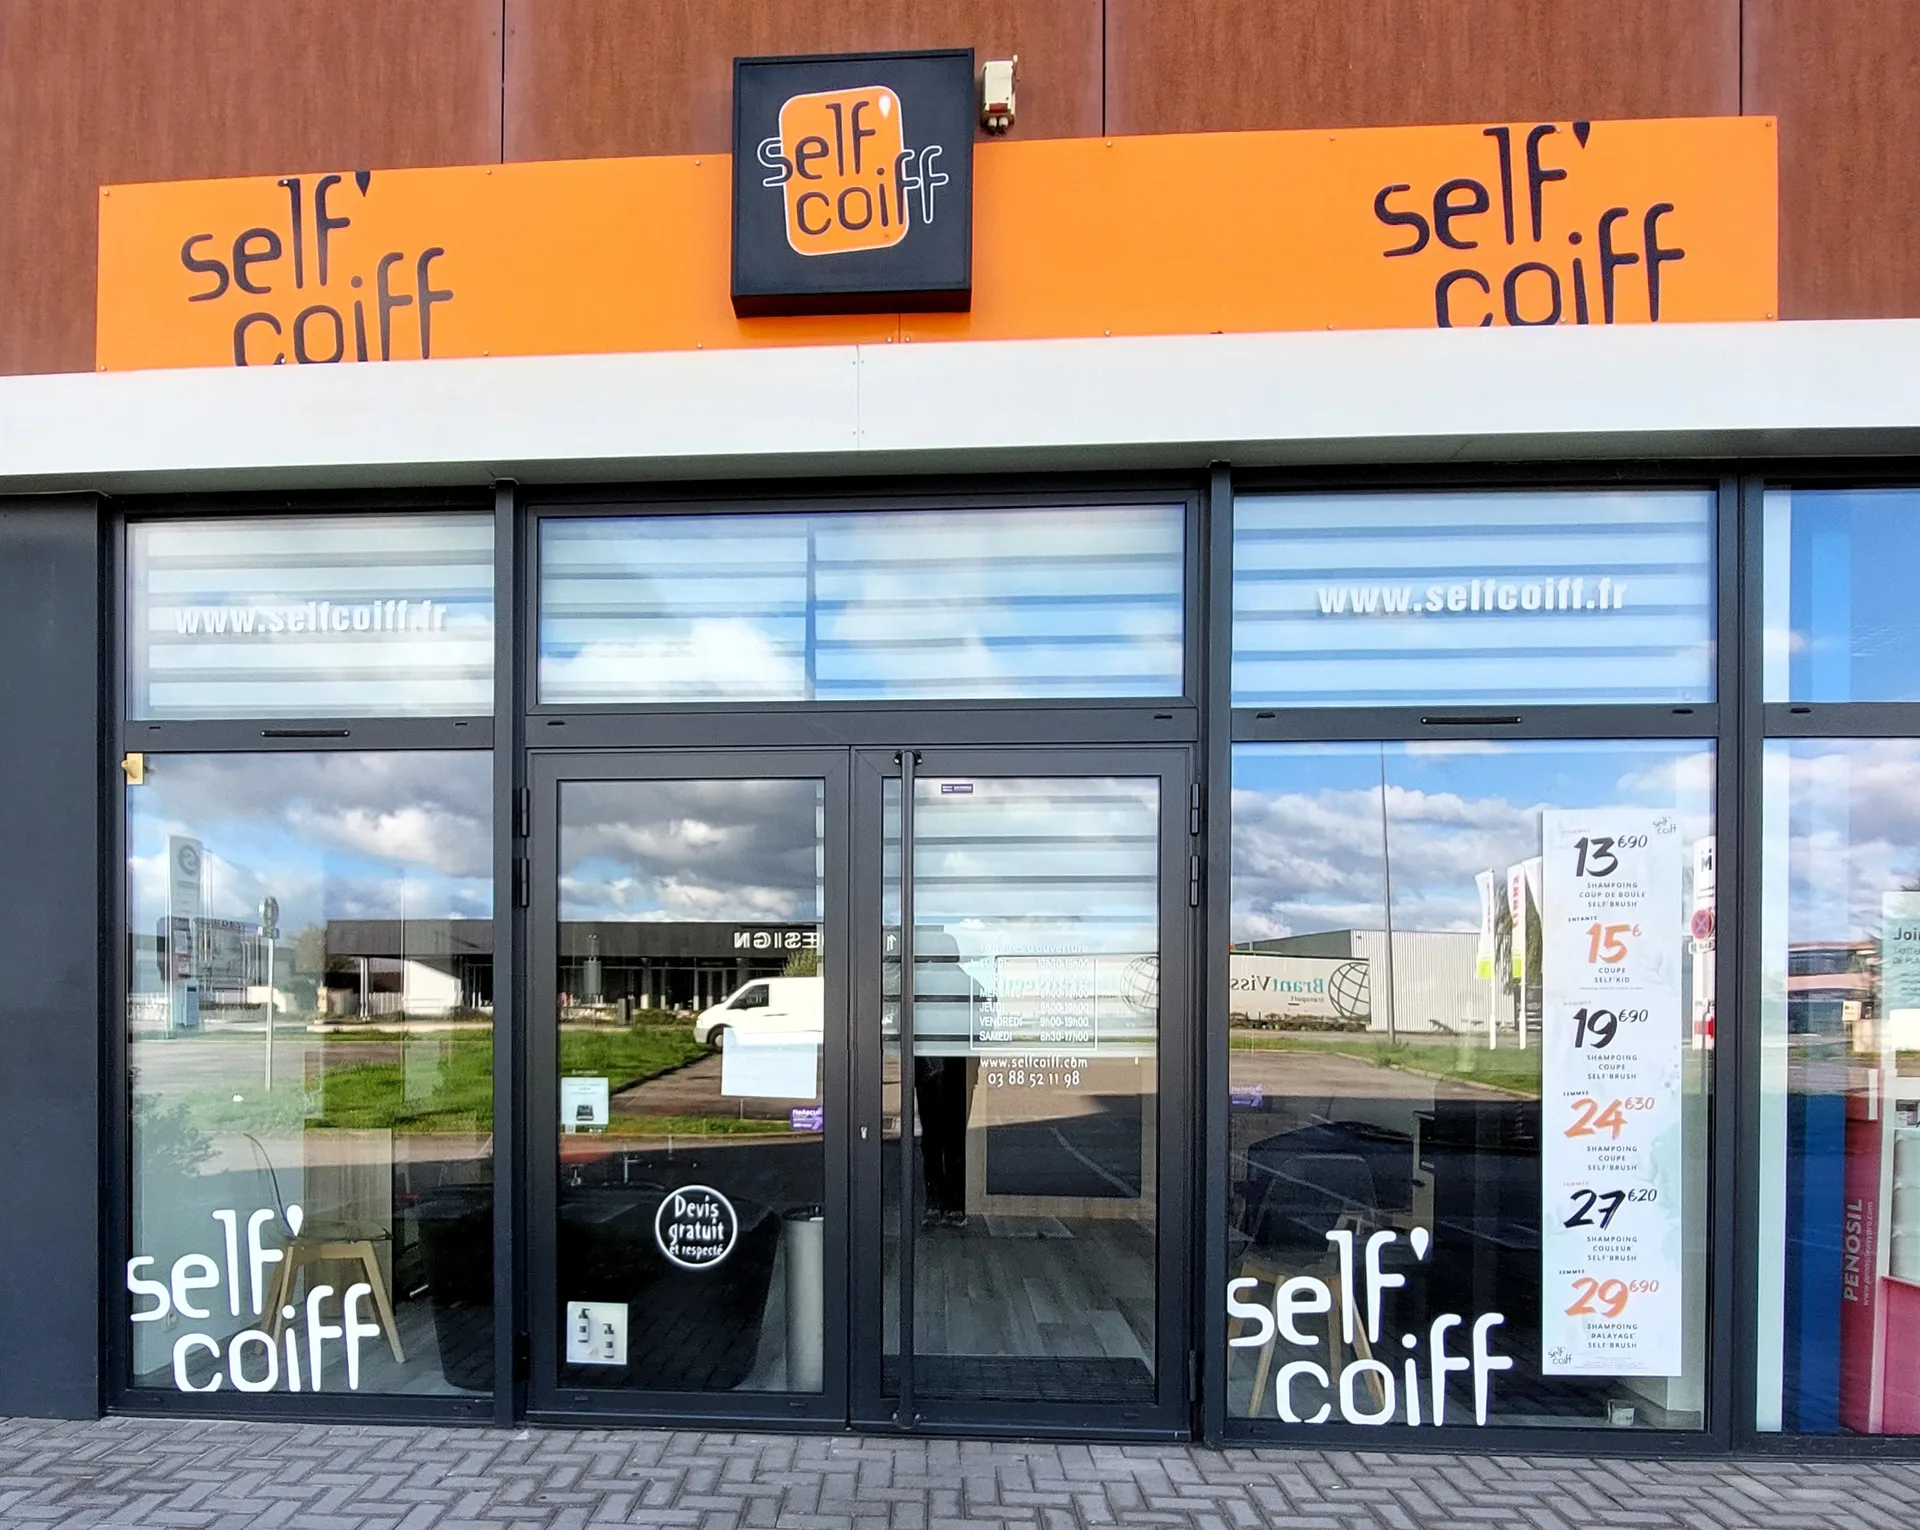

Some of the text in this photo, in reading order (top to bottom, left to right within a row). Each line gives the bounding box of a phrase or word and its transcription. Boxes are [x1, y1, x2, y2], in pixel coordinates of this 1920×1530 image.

[797, 145, 949, 235] coiff
[1435, 203, 1686, 328] coiff
[233, 247, 454, 367] coiff
[1317, 578, 1628, 614] www.selfcoiff.fr
[174, 599, 448, 635] www.selfcoiff.fr
[979, 1016, 1090, 1027] VENDREDI 9h00-19h00
[979, 1031, 1013, 1042] SAMEDI
[979, 1054, 1089, 1069] www.selfcoiff.com
[987, 1070, 1081, 1088] 03 88 52 11 98
[674, 1194, 720, 1219] Devis
[668, 1217, 725, 1246] gratuit
[669, 1244, 724, 1260] et respecté
[1843, 1198, 1863, 1302] PENOSIL
[172, 1283, 380, 1392] coiff
[1276, 1313, 1513, 1427] coiff
